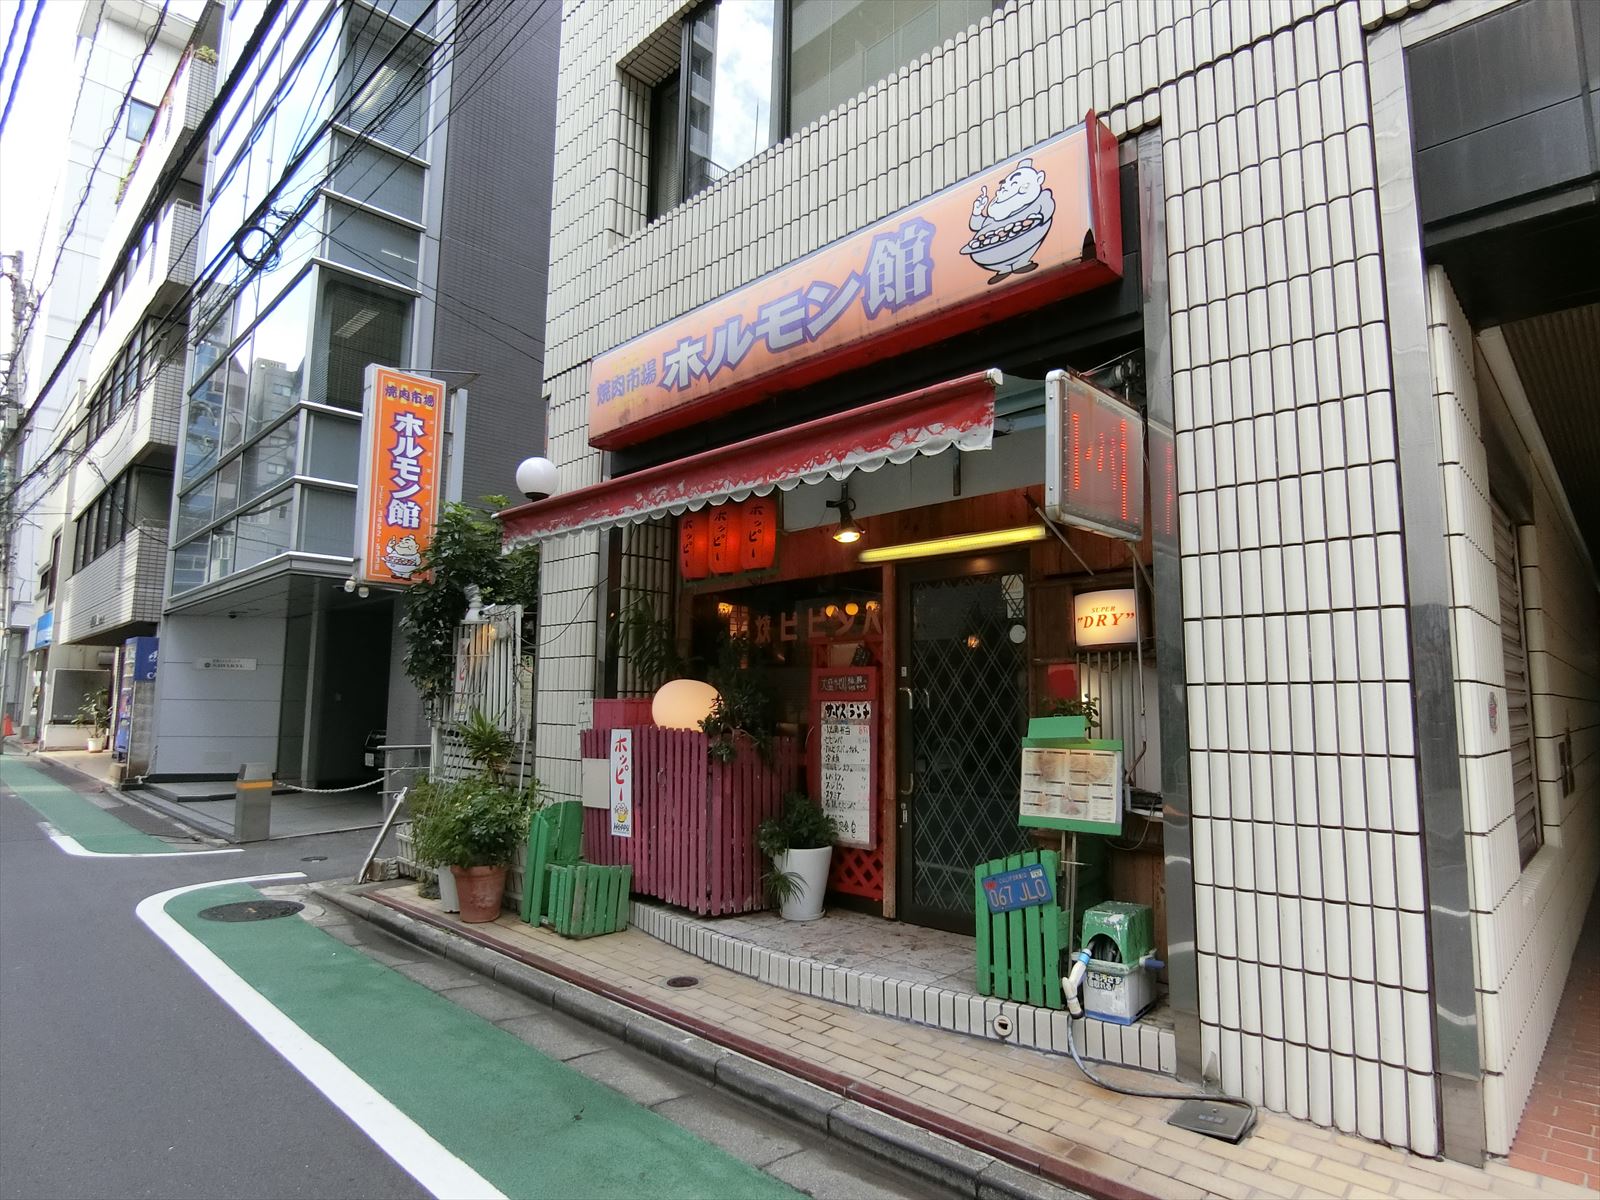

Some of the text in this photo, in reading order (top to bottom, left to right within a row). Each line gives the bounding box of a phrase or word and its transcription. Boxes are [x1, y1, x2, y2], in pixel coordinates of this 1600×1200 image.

[659, 219, 933, 390] ホルモン館
[385, 384, 434, 407] 焼肉市場
[597, 359, 656, 405] 焼肉市場
[387, 412, 425, 528] ホルモン館
[682, 520, 693, 568] ホッピー
[713, 511, 727, 561] ホッピー
[748, 506, 764, 558] ホッピー
[614, 733, 629, 801] ホッピー
[989, 885, 1013, 907] 067
